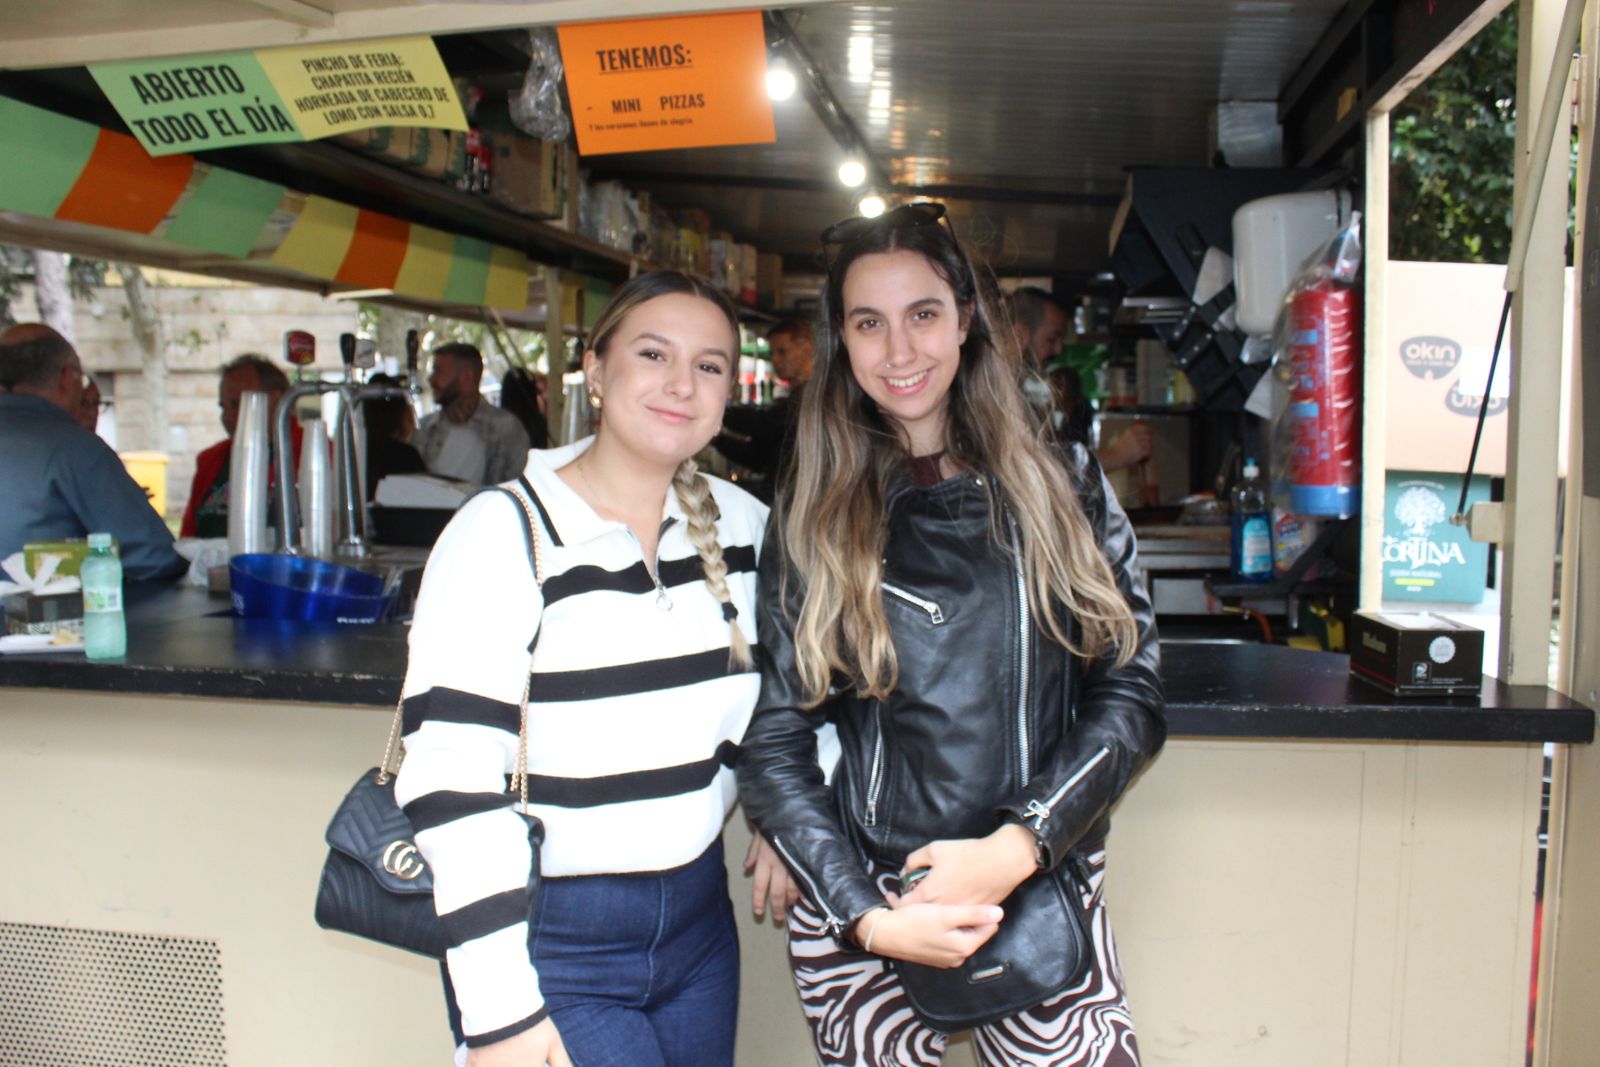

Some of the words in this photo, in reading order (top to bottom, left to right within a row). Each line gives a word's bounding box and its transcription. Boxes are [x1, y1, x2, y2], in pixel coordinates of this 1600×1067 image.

[302, 55, 349, 73] PINCHO
[348, 54, 364, 69] DE
[365, 52, 405, 68] FERIA:
[596, 44, 692, 71] TENEMOS:
[129, 64, 245, 105] ABIERTO
[311, 71, 373, 90] CHAPATITA
[294, 90, 357, 113] HORNEADA
[356, 88, 373, 102] DE
[374, 86, 433, 102] CABECERO
[433, 87, 450, 103] DE
[611, 97, 642, 114] MINI
[659, 93, 705, 111] PIZZAS
[132, 112, 209, 147] TODO
[206, 107, 246, 137] EL
[240, 96, 295, 133] DÍA
[323, 106, 357, 125] LOMO
[357, 104, 383, 119] CON
[382, 103, 417, 118] SALSA
[1406, 341, 1456, 360] okin
